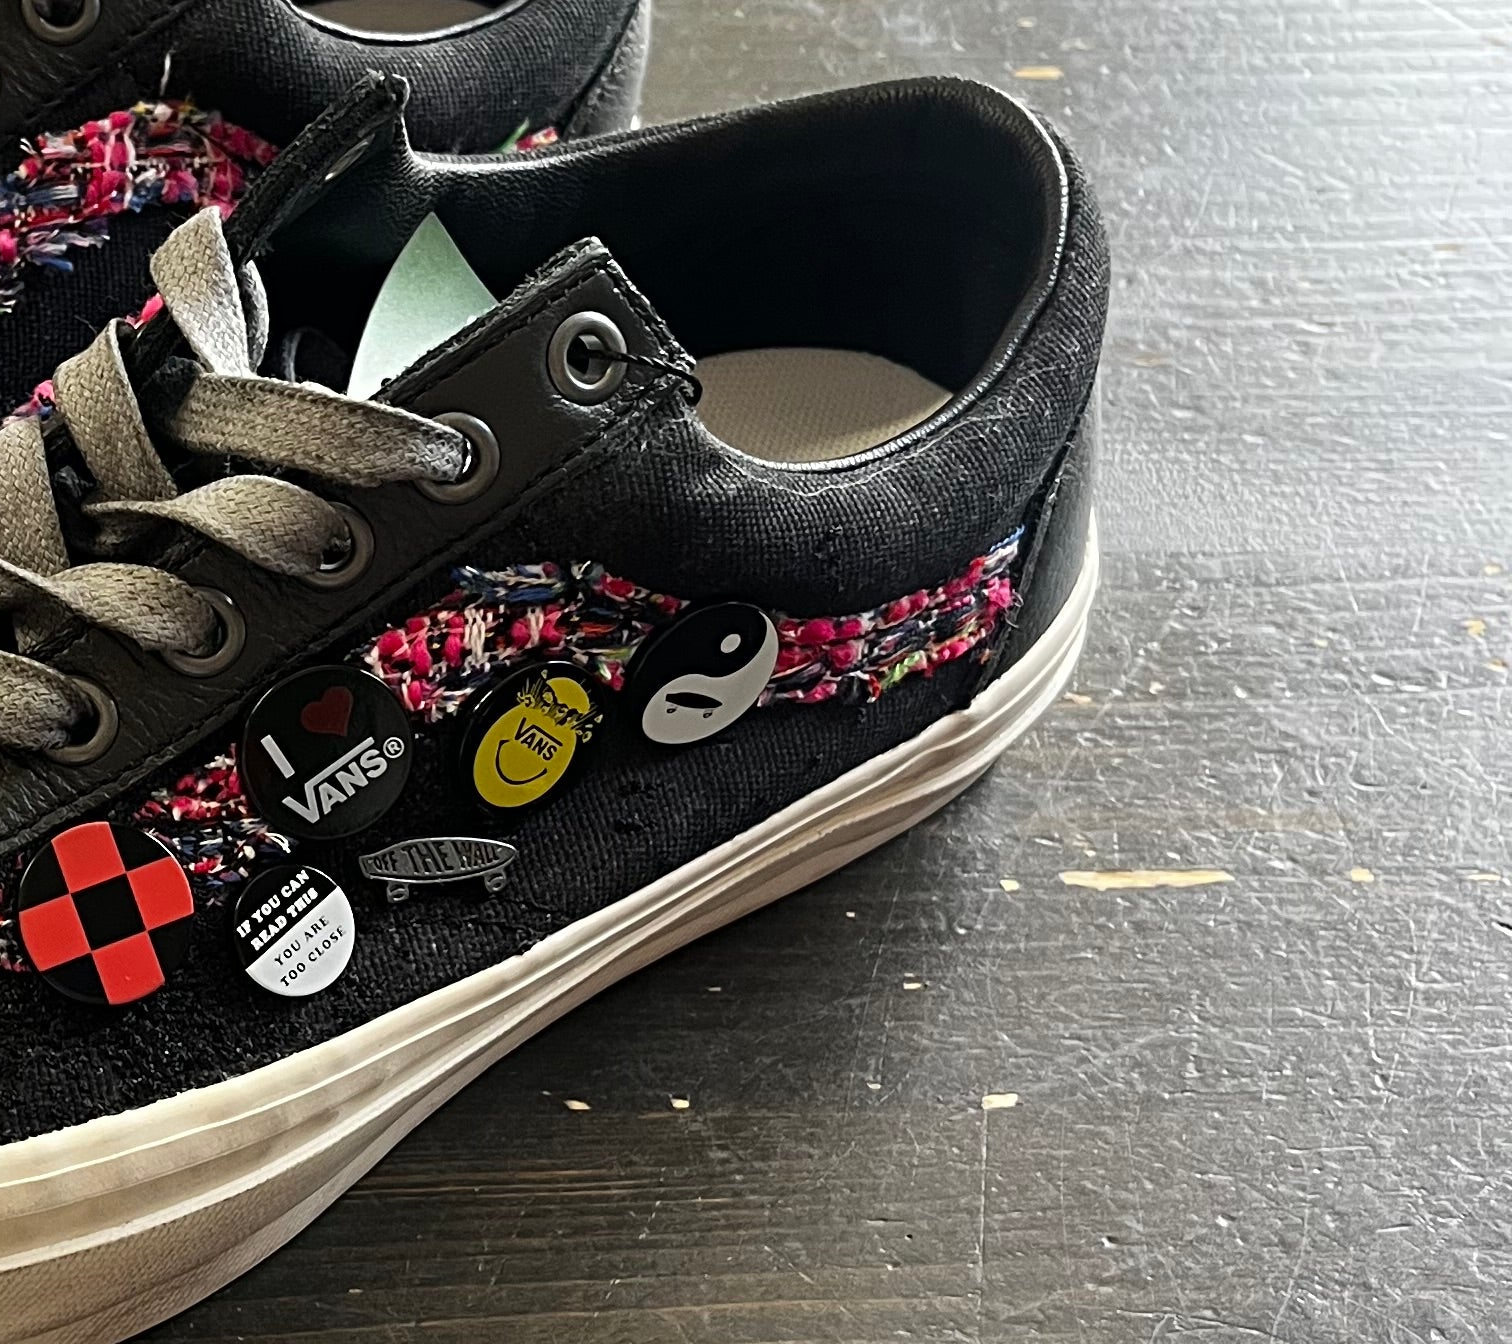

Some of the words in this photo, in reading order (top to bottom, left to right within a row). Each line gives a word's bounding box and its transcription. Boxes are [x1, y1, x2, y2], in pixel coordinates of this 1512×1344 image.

[260, 734, 296, 779] I
[514, 717, 563, 761] VANS
[373, 850, 398, 873] OFF
[400, 841, 454, 874] THE
[450, 840, 500, 870] WALL
[236, 919, 251, 938] IF
[251, 894, 281, 923] YOU
[280, 869, 310, 898] CAN
[250, 915, 287, 951] READ
[286, 887, 319, 918] THIS
[274, 939, 301, 966] YOU
[304, 915, 330, 942] ARE
[280, 962, 306, 987] TOO
[308, 924, 347, 962] CLOSE
